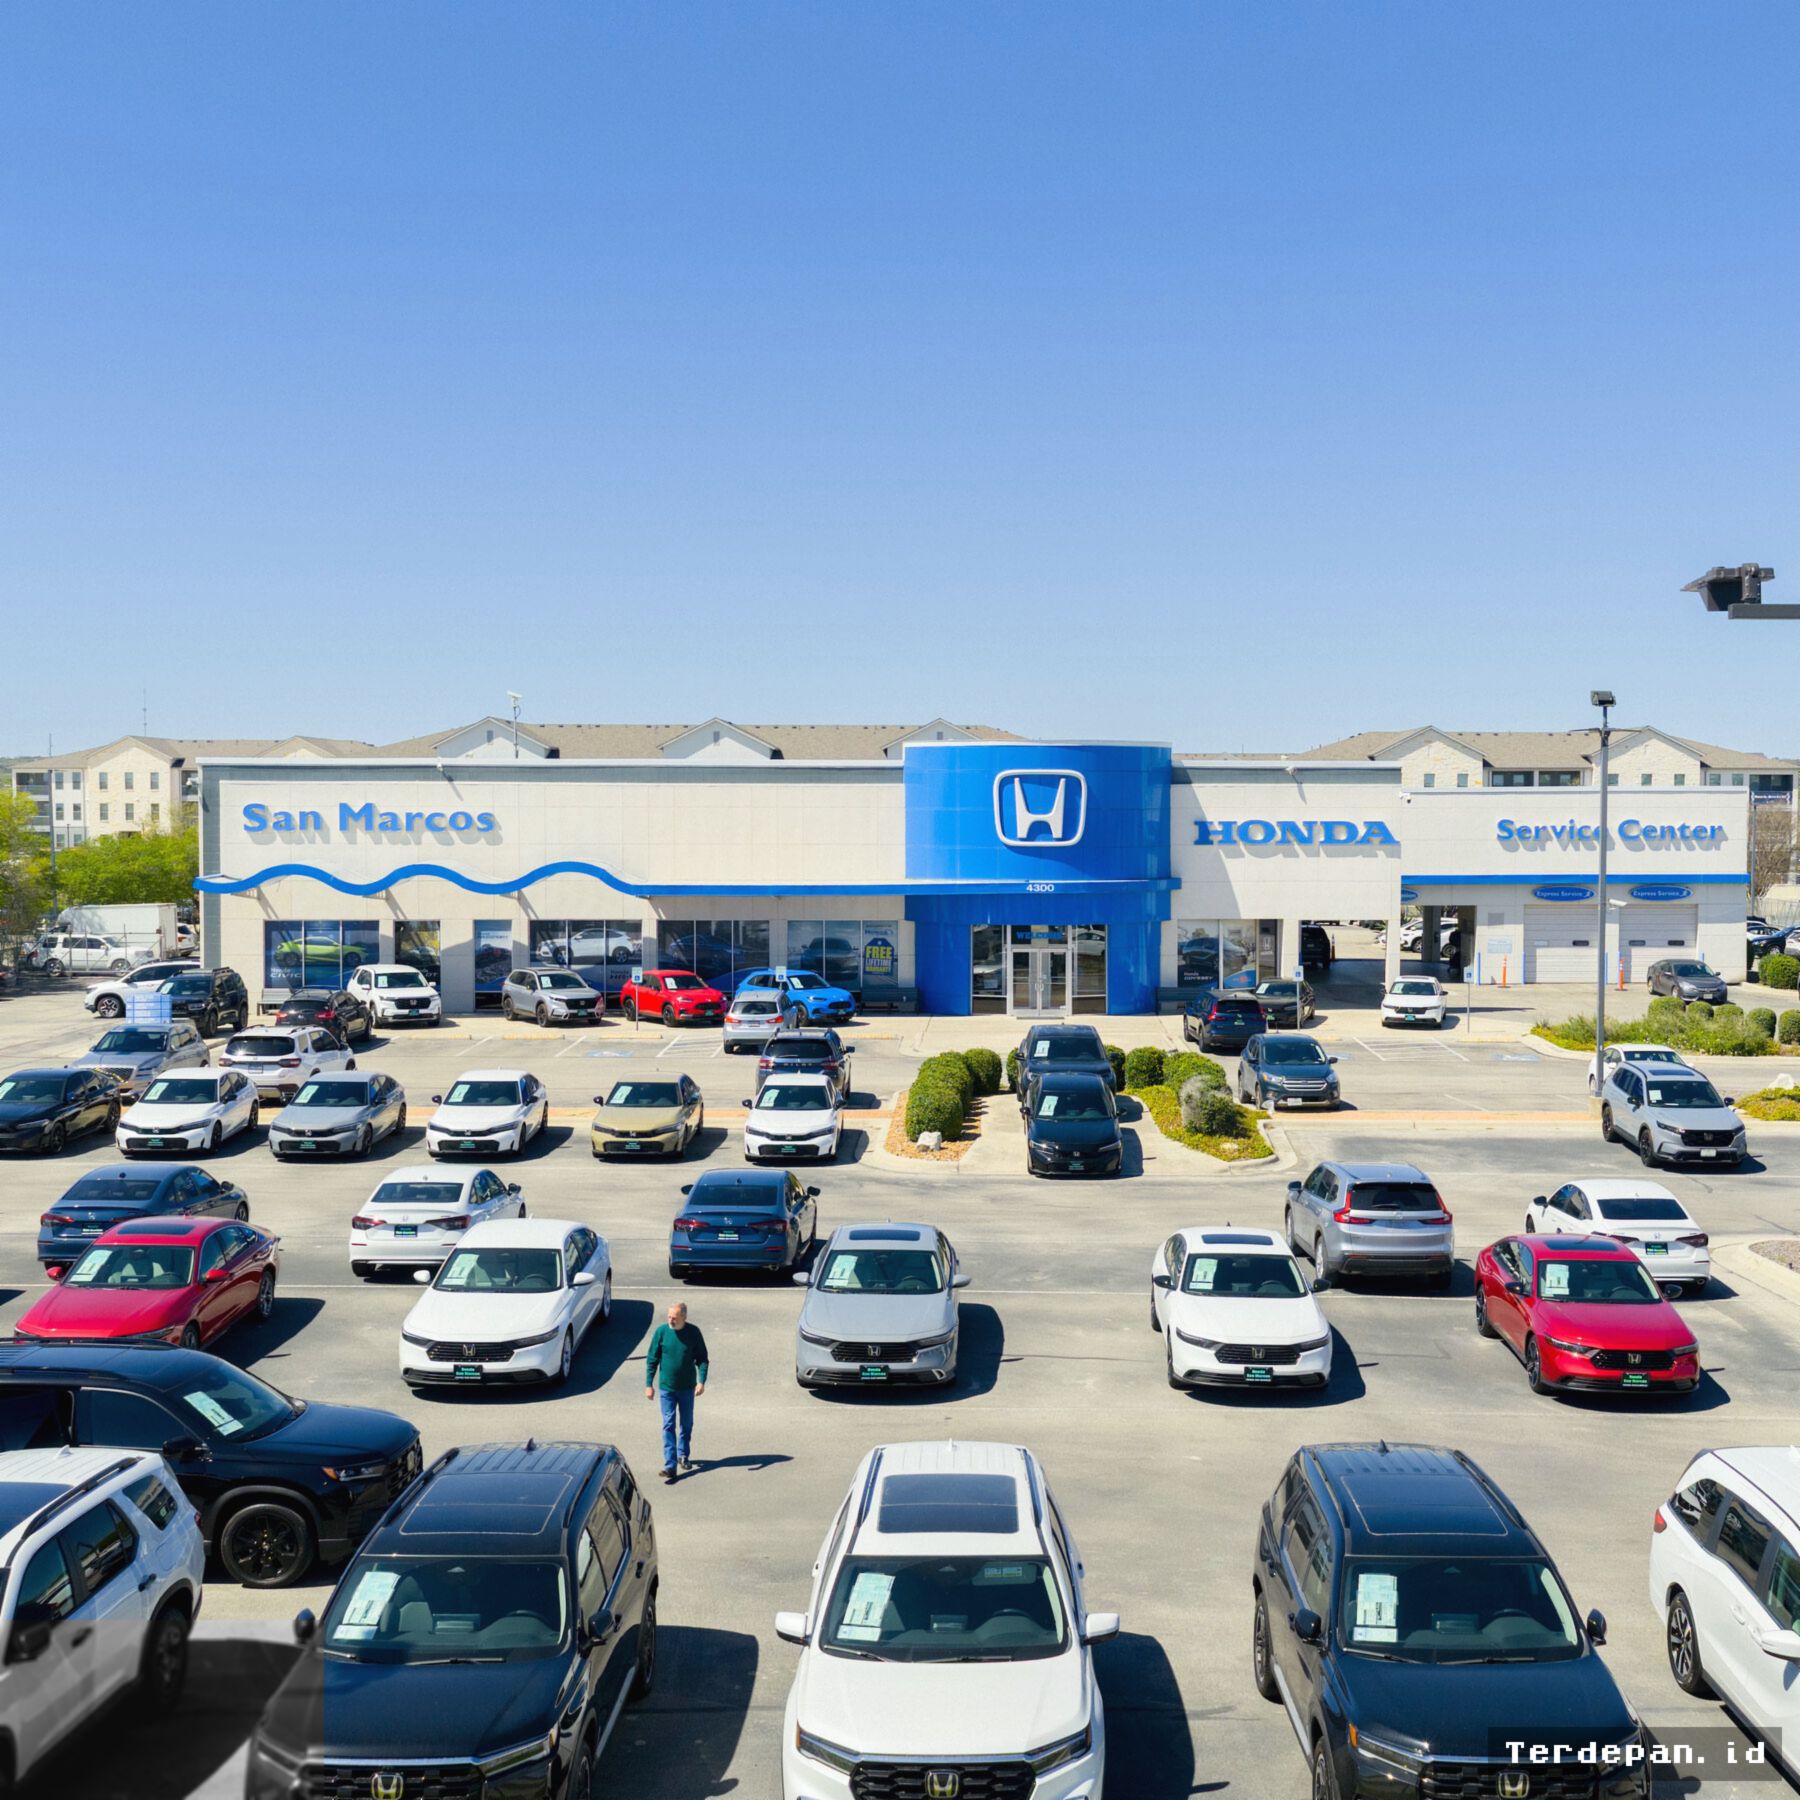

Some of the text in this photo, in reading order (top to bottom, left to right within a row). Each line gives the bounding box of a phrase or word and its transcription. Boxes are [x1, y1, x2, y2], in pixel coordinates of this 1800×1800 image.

[242, 802, 495, 832] San Marcos
[1193, 819, 1400, 845] HONDA
[1618, 819, 1723, 840] Center
[1026, 884, 1055, 892] 4300
[1633, 890, 1657, 898] Express
[865, 946, 893, 959] FREE
